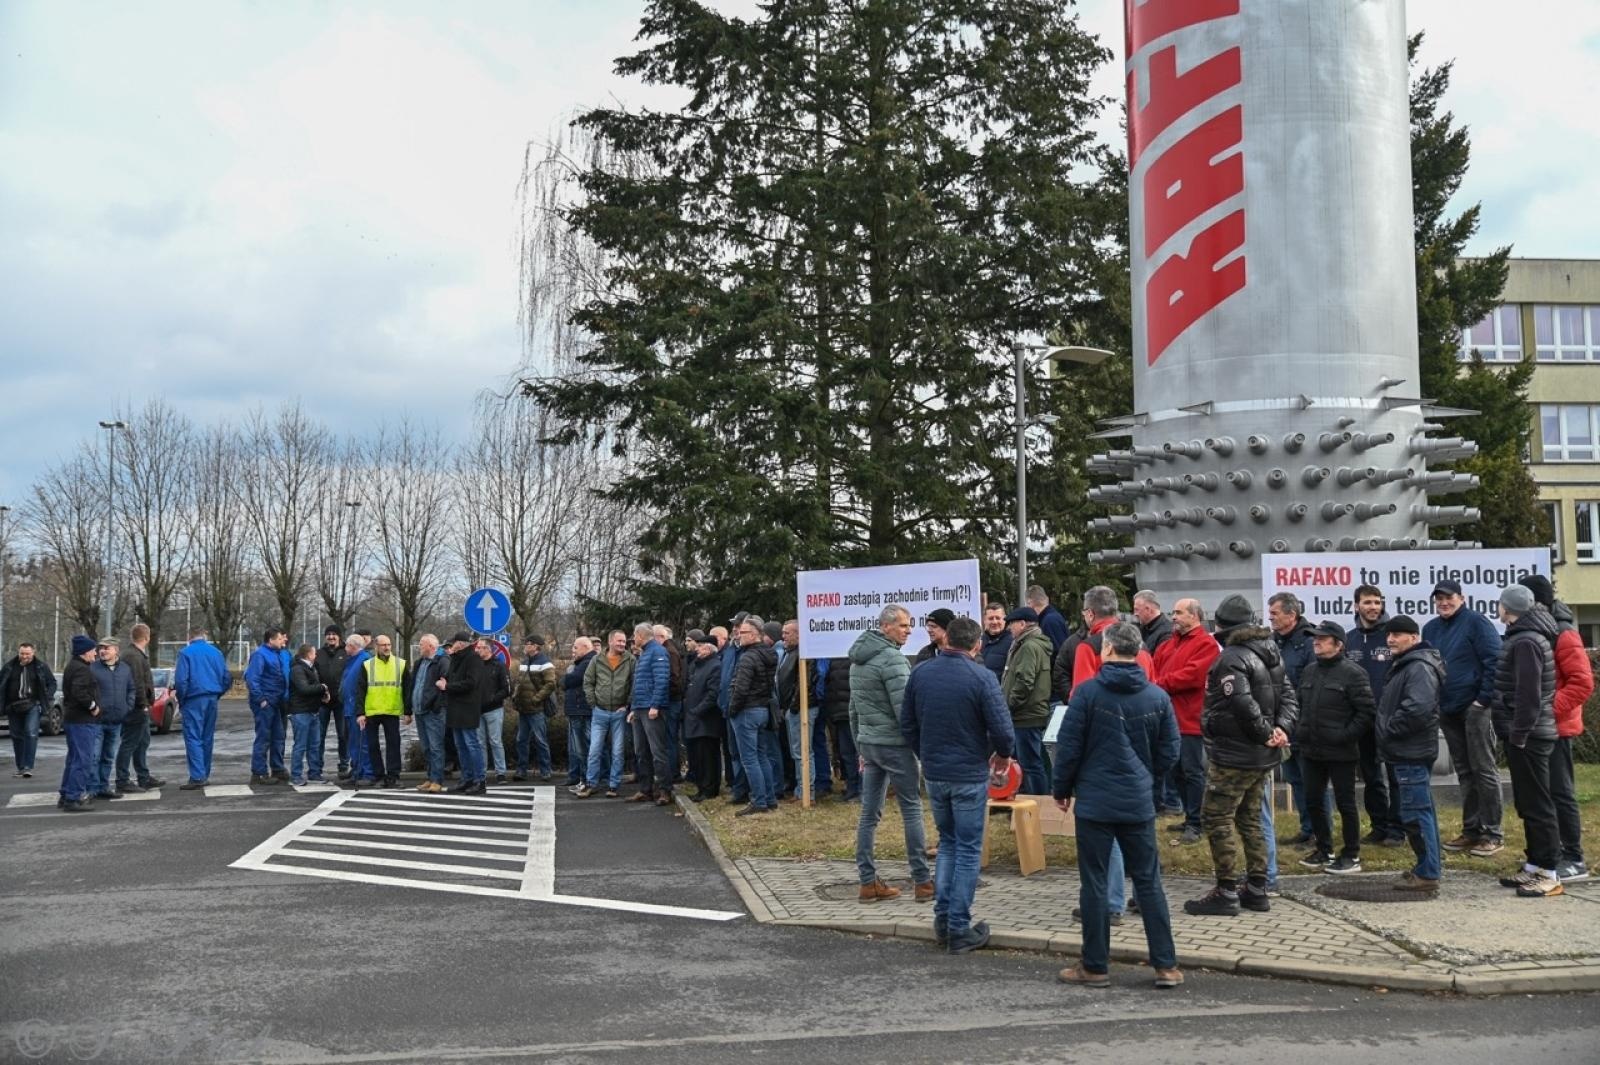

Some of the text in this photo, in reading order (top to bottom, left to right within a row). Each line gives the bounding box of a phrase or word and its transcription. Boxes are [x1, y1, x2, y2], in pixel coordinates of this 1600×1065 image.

[1275, 566, 1352, 586] RAFAKO
[1360, 567, 1380, 585] to
[1389, 566, 1420, 585] nie
[806, 584, 971, 609] RAFAKO zastąpią zachodnie firmy(?!)
[1314, 596, 1353, 615] ludz
[809, 618, 835, 632] Cudze
